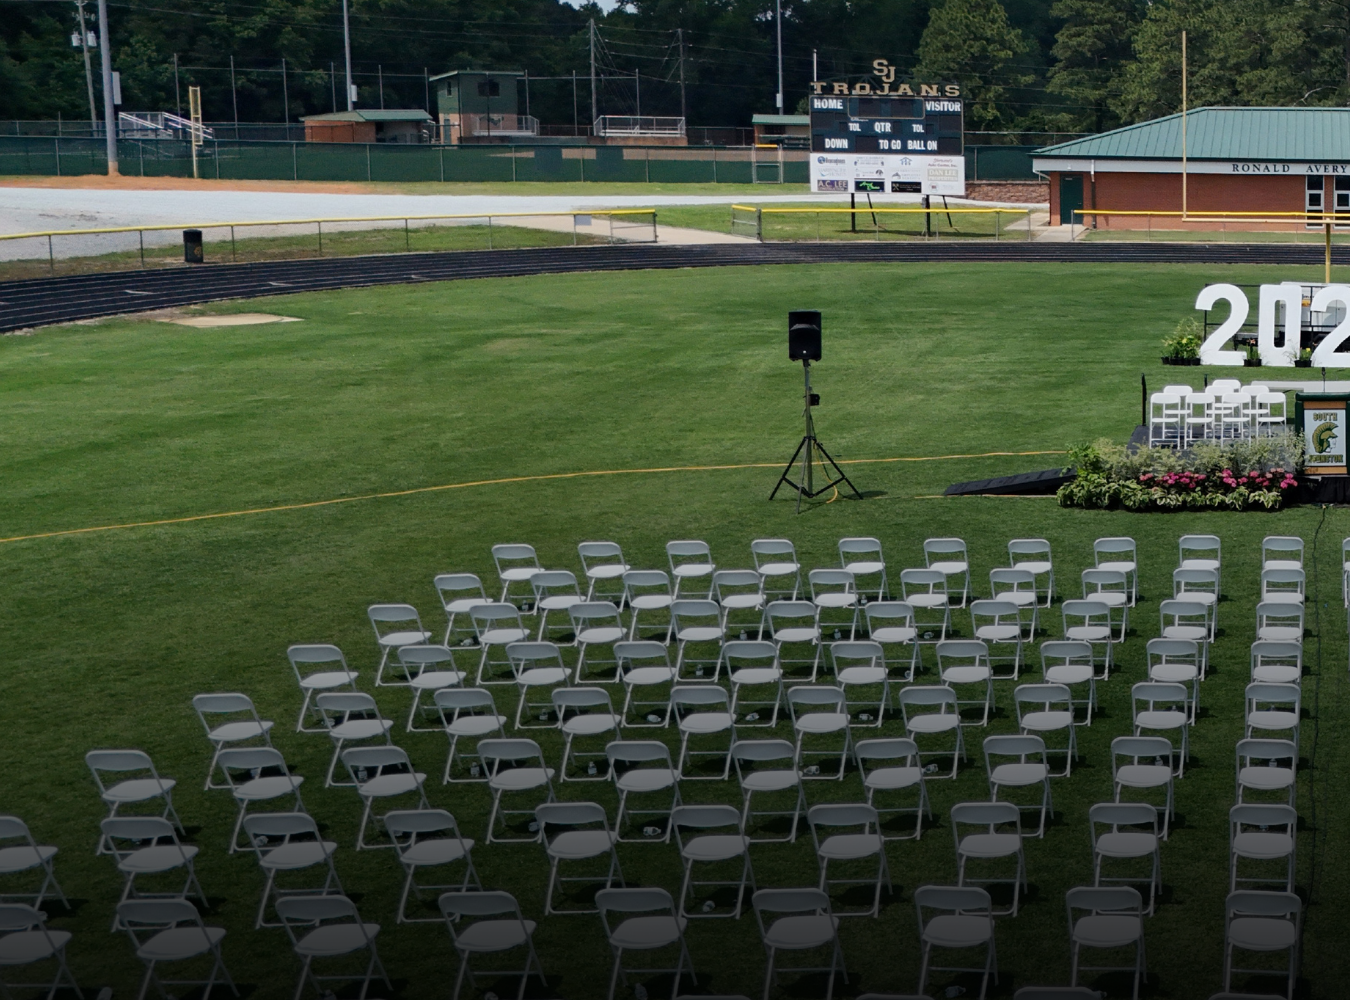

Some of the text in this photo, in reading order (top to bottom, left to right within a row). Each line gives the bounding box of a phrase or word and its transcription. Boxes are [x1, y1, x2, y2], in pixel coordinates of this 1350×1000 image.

[873, 59, 896, 82] SJ
[810, 82, 960, 97] TROJANS
[813, 99, 843, 109] HOME
[925, 101, 961, 111] VISITOR
[848, 122, 861, 131] TOL
[874, 122, 891, 133] QTR
[912, 124, 924, 133] TOL
[825, 138, 848, 149] DOWN
[878, 139, 901, 150] TO GO
[907, 140, 938, 151] BALL ON
[1232, 163, 1290, 173] RONALD
[1306, 164, 1348, 174] AVERY
[834, 180, 847, 188] LEE
[1313, 412, 1338, 421] SOUTH
